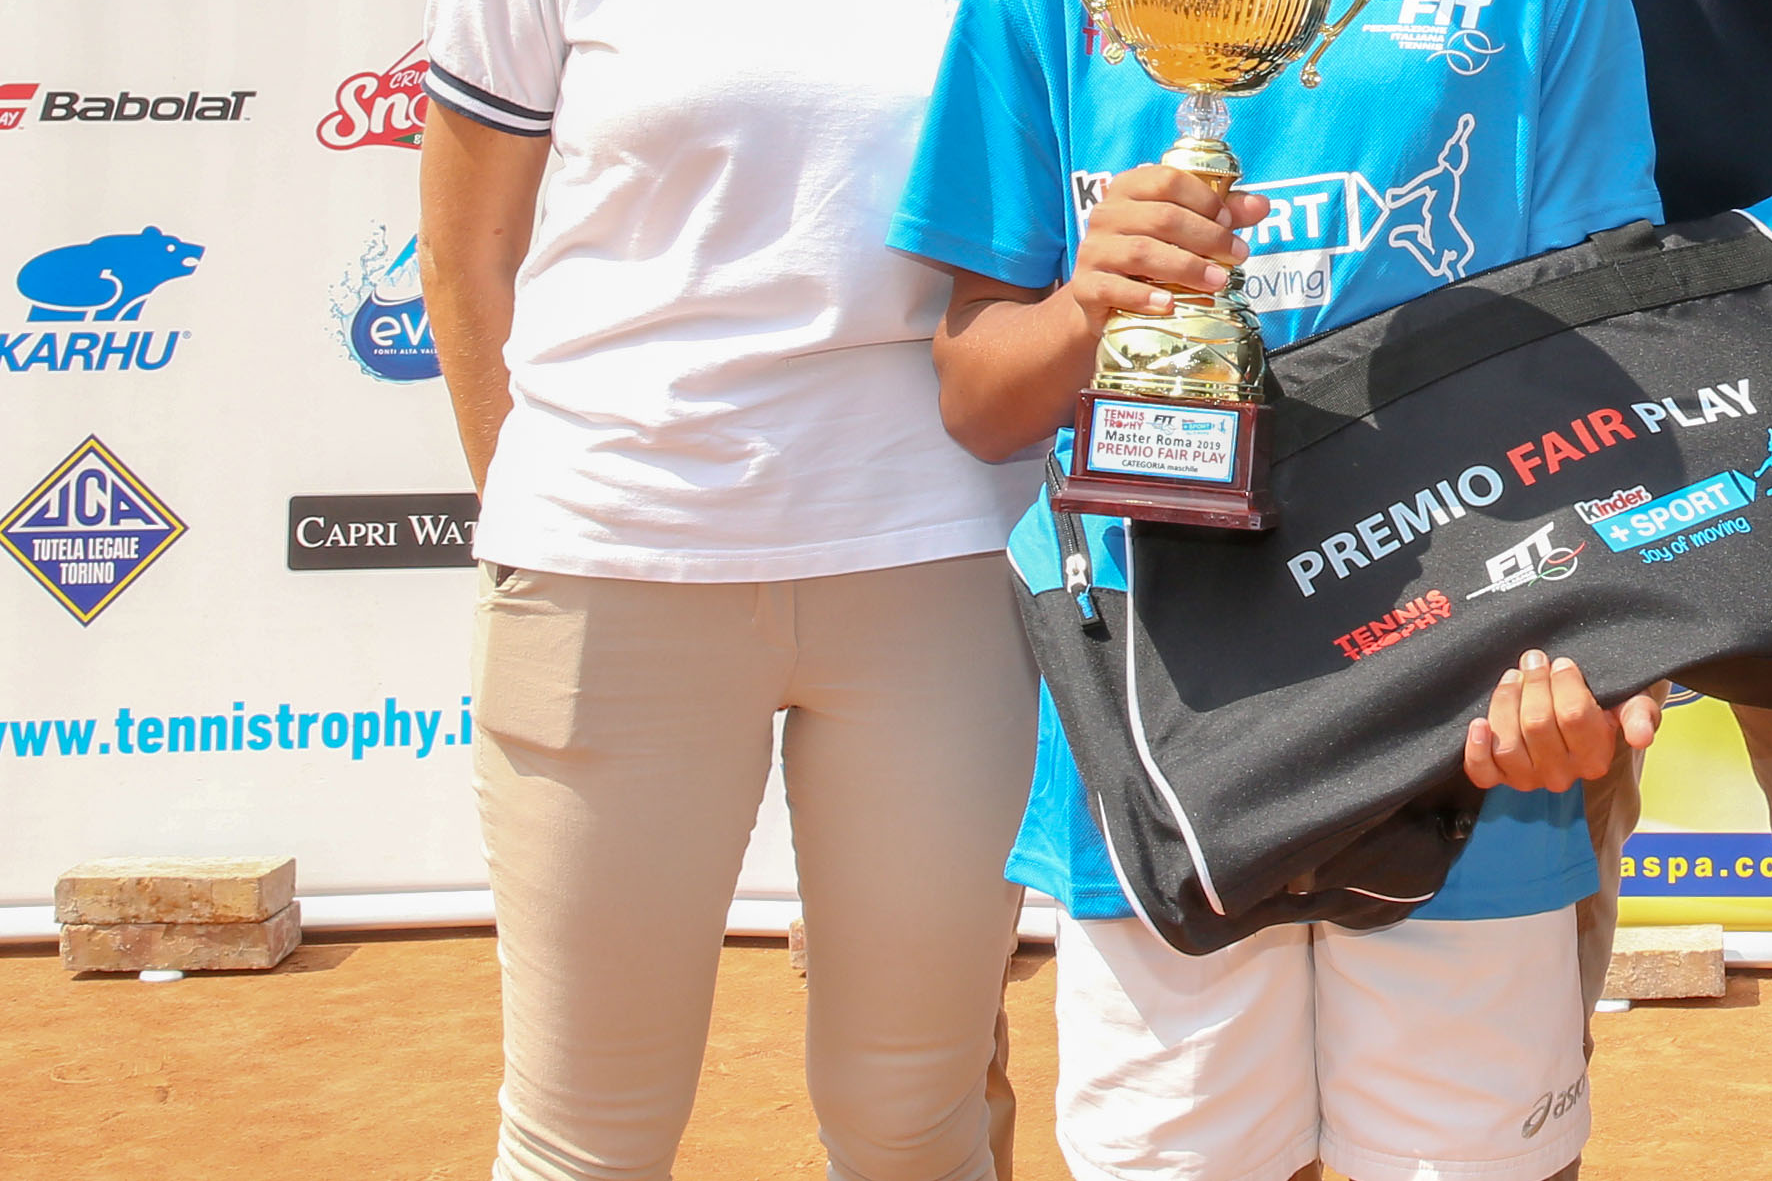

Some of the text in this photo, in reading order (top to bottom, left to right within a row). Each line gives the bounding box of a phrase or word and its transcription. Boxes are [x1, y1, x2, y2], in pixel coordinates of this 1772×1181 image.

[1104, 408, 1145, 421] TENNIS
[1104, 419, 1144, 430] TROPHY
[1154, 415, 1176, 425] FIT
[1105, 430, 1221, 450] Master Roma 2019
[1097, 442, 1226, 464] PREMIO FAIR PLAY
[1122, 459, 1165, 470] CATEGORIA
[1286, 464, 1504, 598] PREMIO
[1505, 407, 1637, 487] FAIR
[1630, 378, 1758, 434] PLAY
[33, 537, 139, 561] TUTELA LEGALE
[1639, 517, 1752, 564] Joy of moving
[1485, 521, 1554, 583] FIT
[60, 562, 115, 585] TORINO
[1333, 589, 1449, 651] TENNIS
